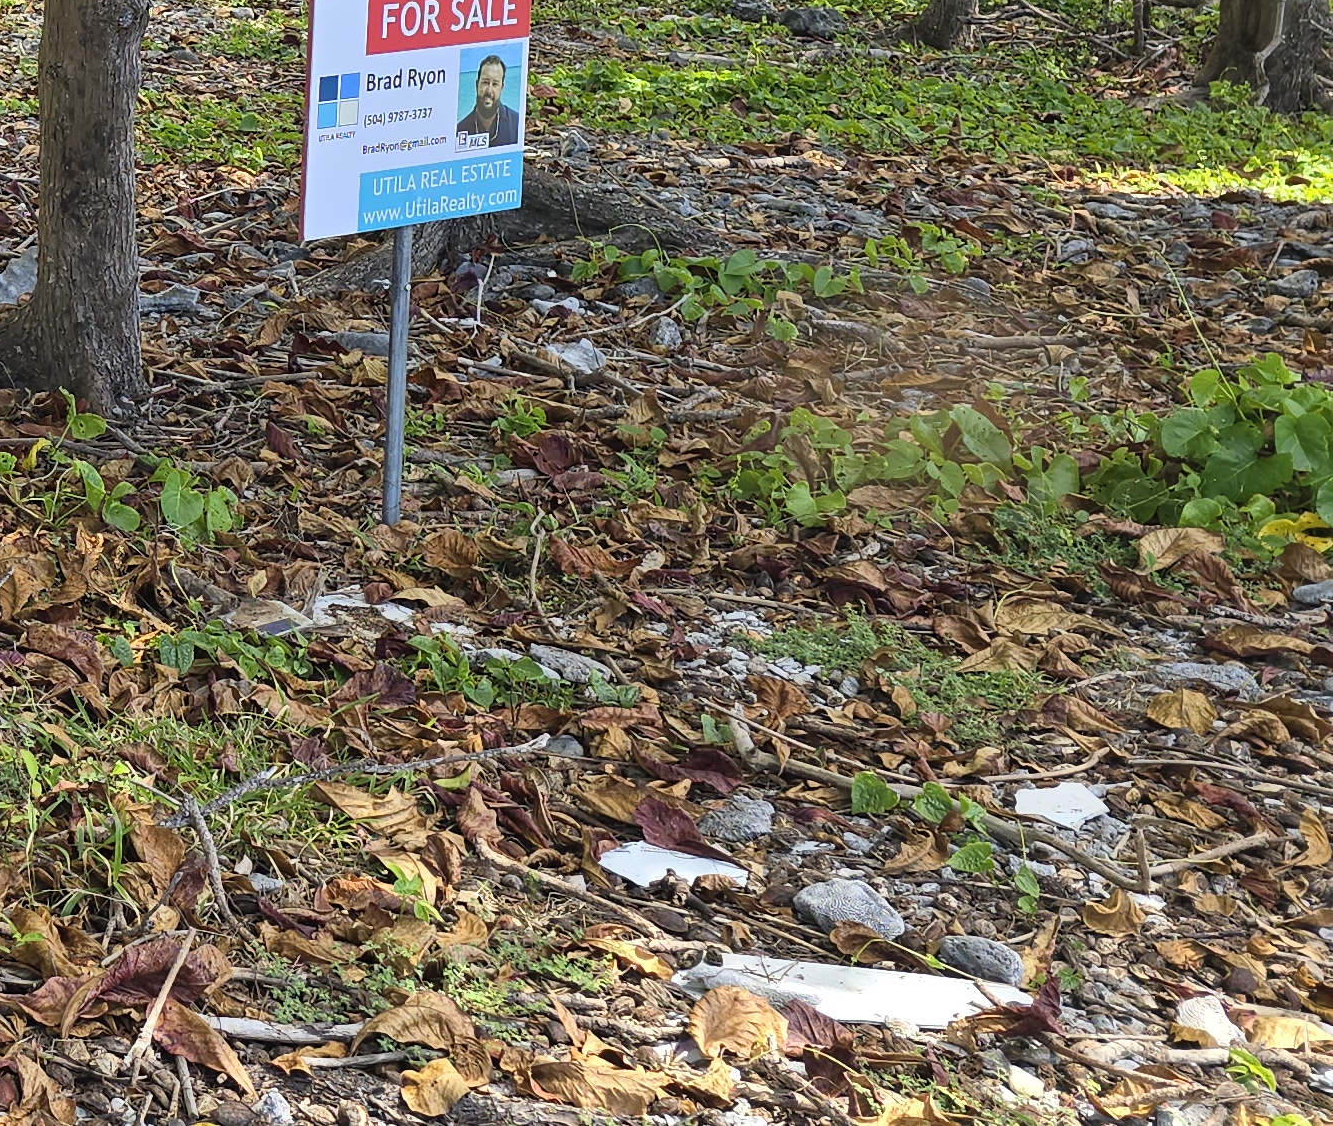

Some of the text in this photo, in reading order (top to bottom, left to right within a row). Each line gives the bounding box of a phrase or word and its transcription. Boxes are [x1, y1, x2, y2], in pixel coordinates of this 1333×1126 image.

[366, 67, 447, 92] Brad Ryon
[363, 107, 433, 129] (504) 9787-3737
[372, 159, 512, 196] UTILA REAL ESTATE
[363, 188, 517, 224] www.UtilaRealty.com
